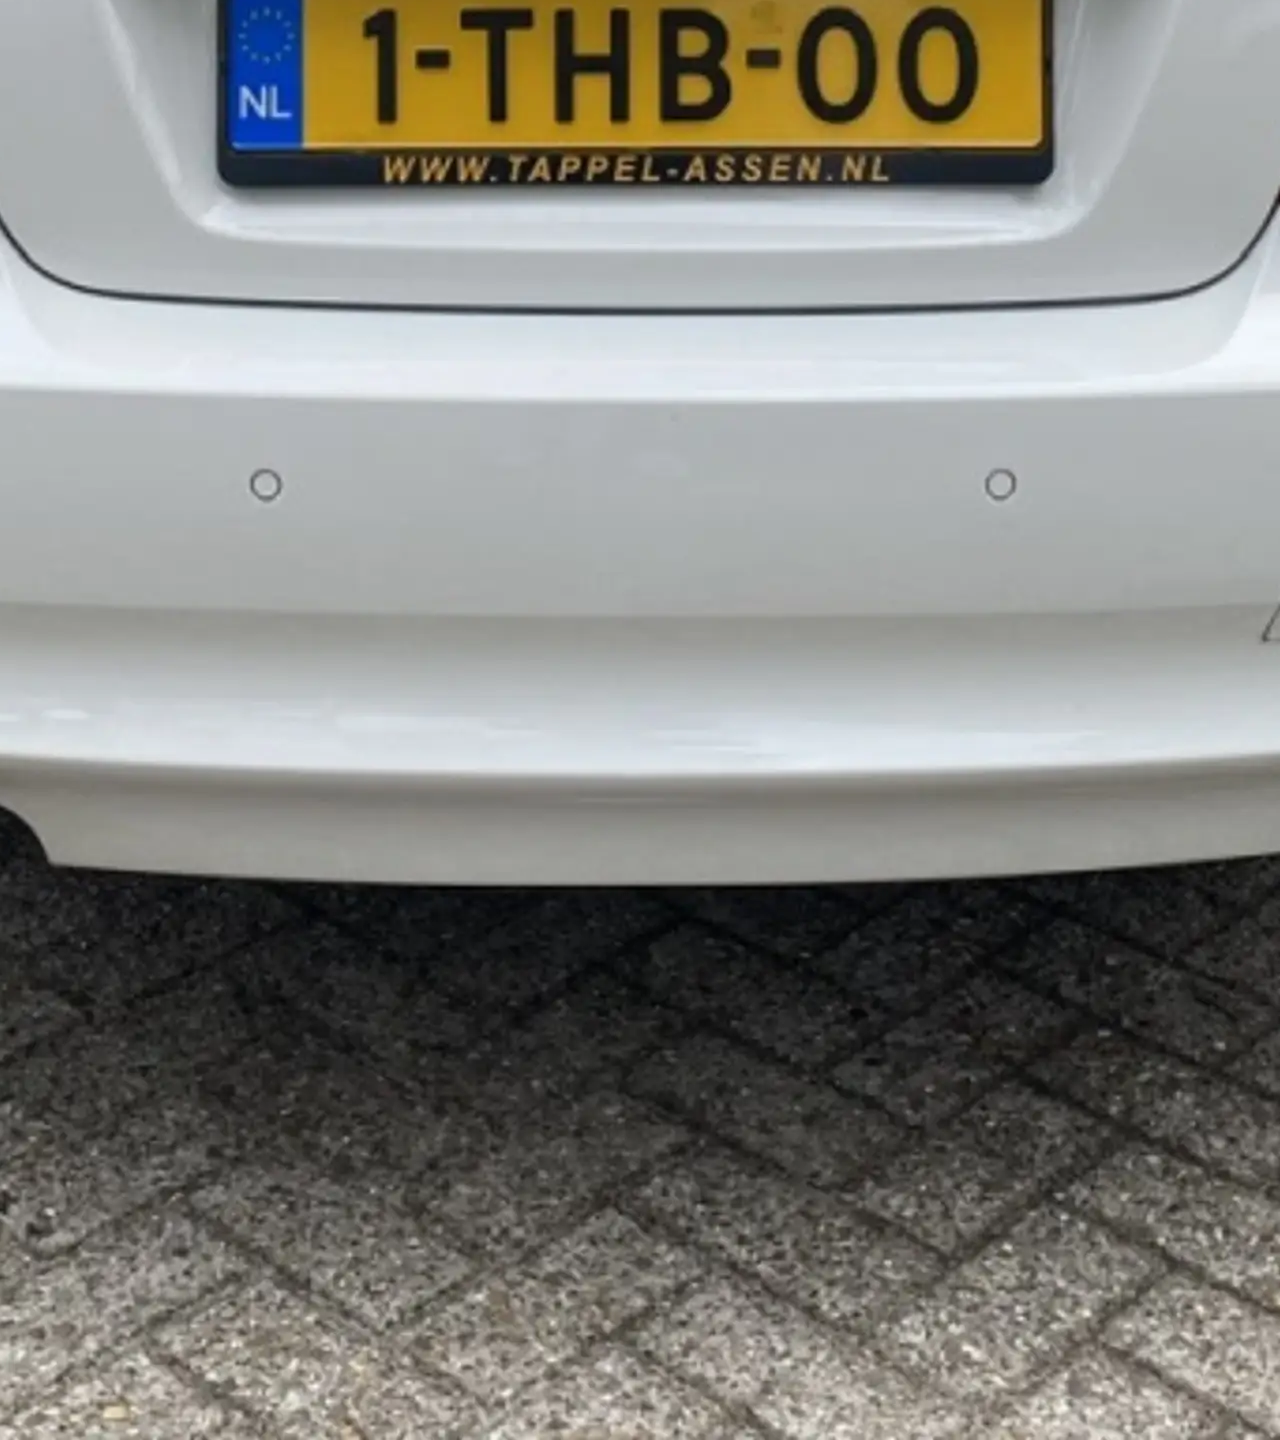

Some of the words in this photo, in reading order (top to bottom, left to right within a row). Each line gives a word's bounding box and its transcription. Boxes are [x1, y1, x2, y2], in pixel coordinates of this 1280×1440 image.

[361, 7, 980, 125] 1-THB-00
[238, 86, 292, 120] NL
[382, 155, 892, 184] WWW.TAPPEL-ASSEN.NL
